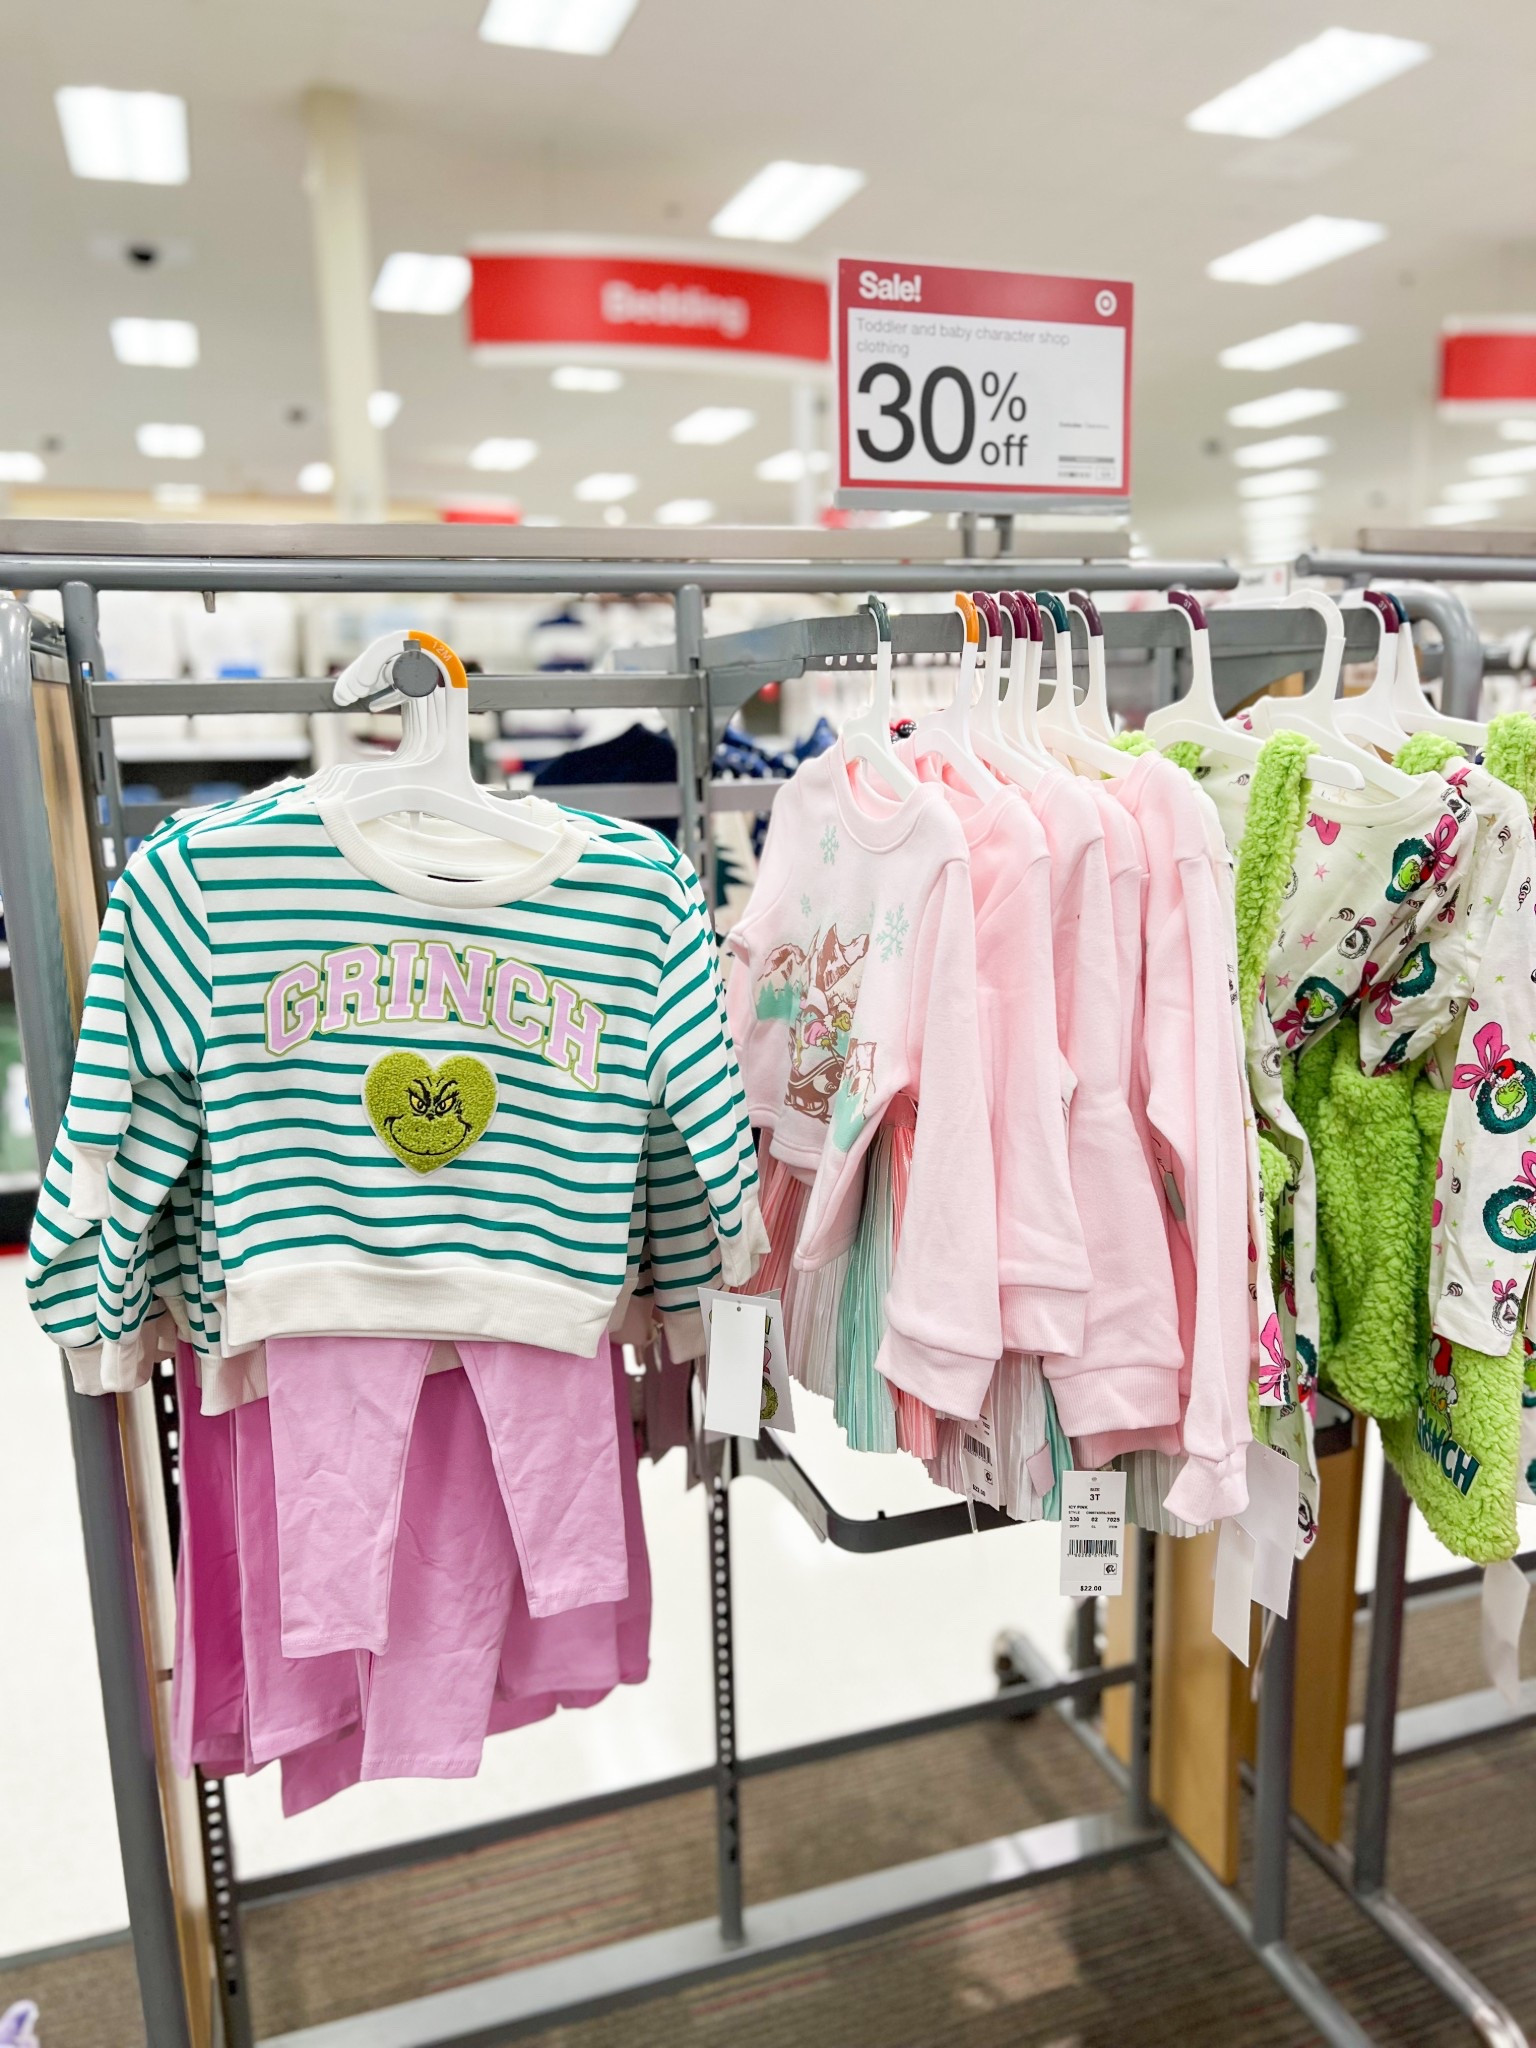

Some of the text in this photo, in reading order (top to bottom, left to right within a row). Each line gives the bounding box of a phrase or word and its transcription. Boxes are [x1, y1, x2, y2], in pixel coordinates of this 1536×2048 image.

[858, 269, 922, 303] Sale!
[600, 280, 749, 339] Bedding
[856, 317, 1071, 347] Toddler and baby character shop
[856, 338, 910, 358] clothing
[980, 434, 1028, 466] off
[1183, 600, 1193, 610] 3T
[1378, 600, 1388, 611] 3T
[432, 641, 453, 662] 12M
[264, 939, 606, 1092] GRINCH
[1089, 1493, 1101, 1501] 3T
